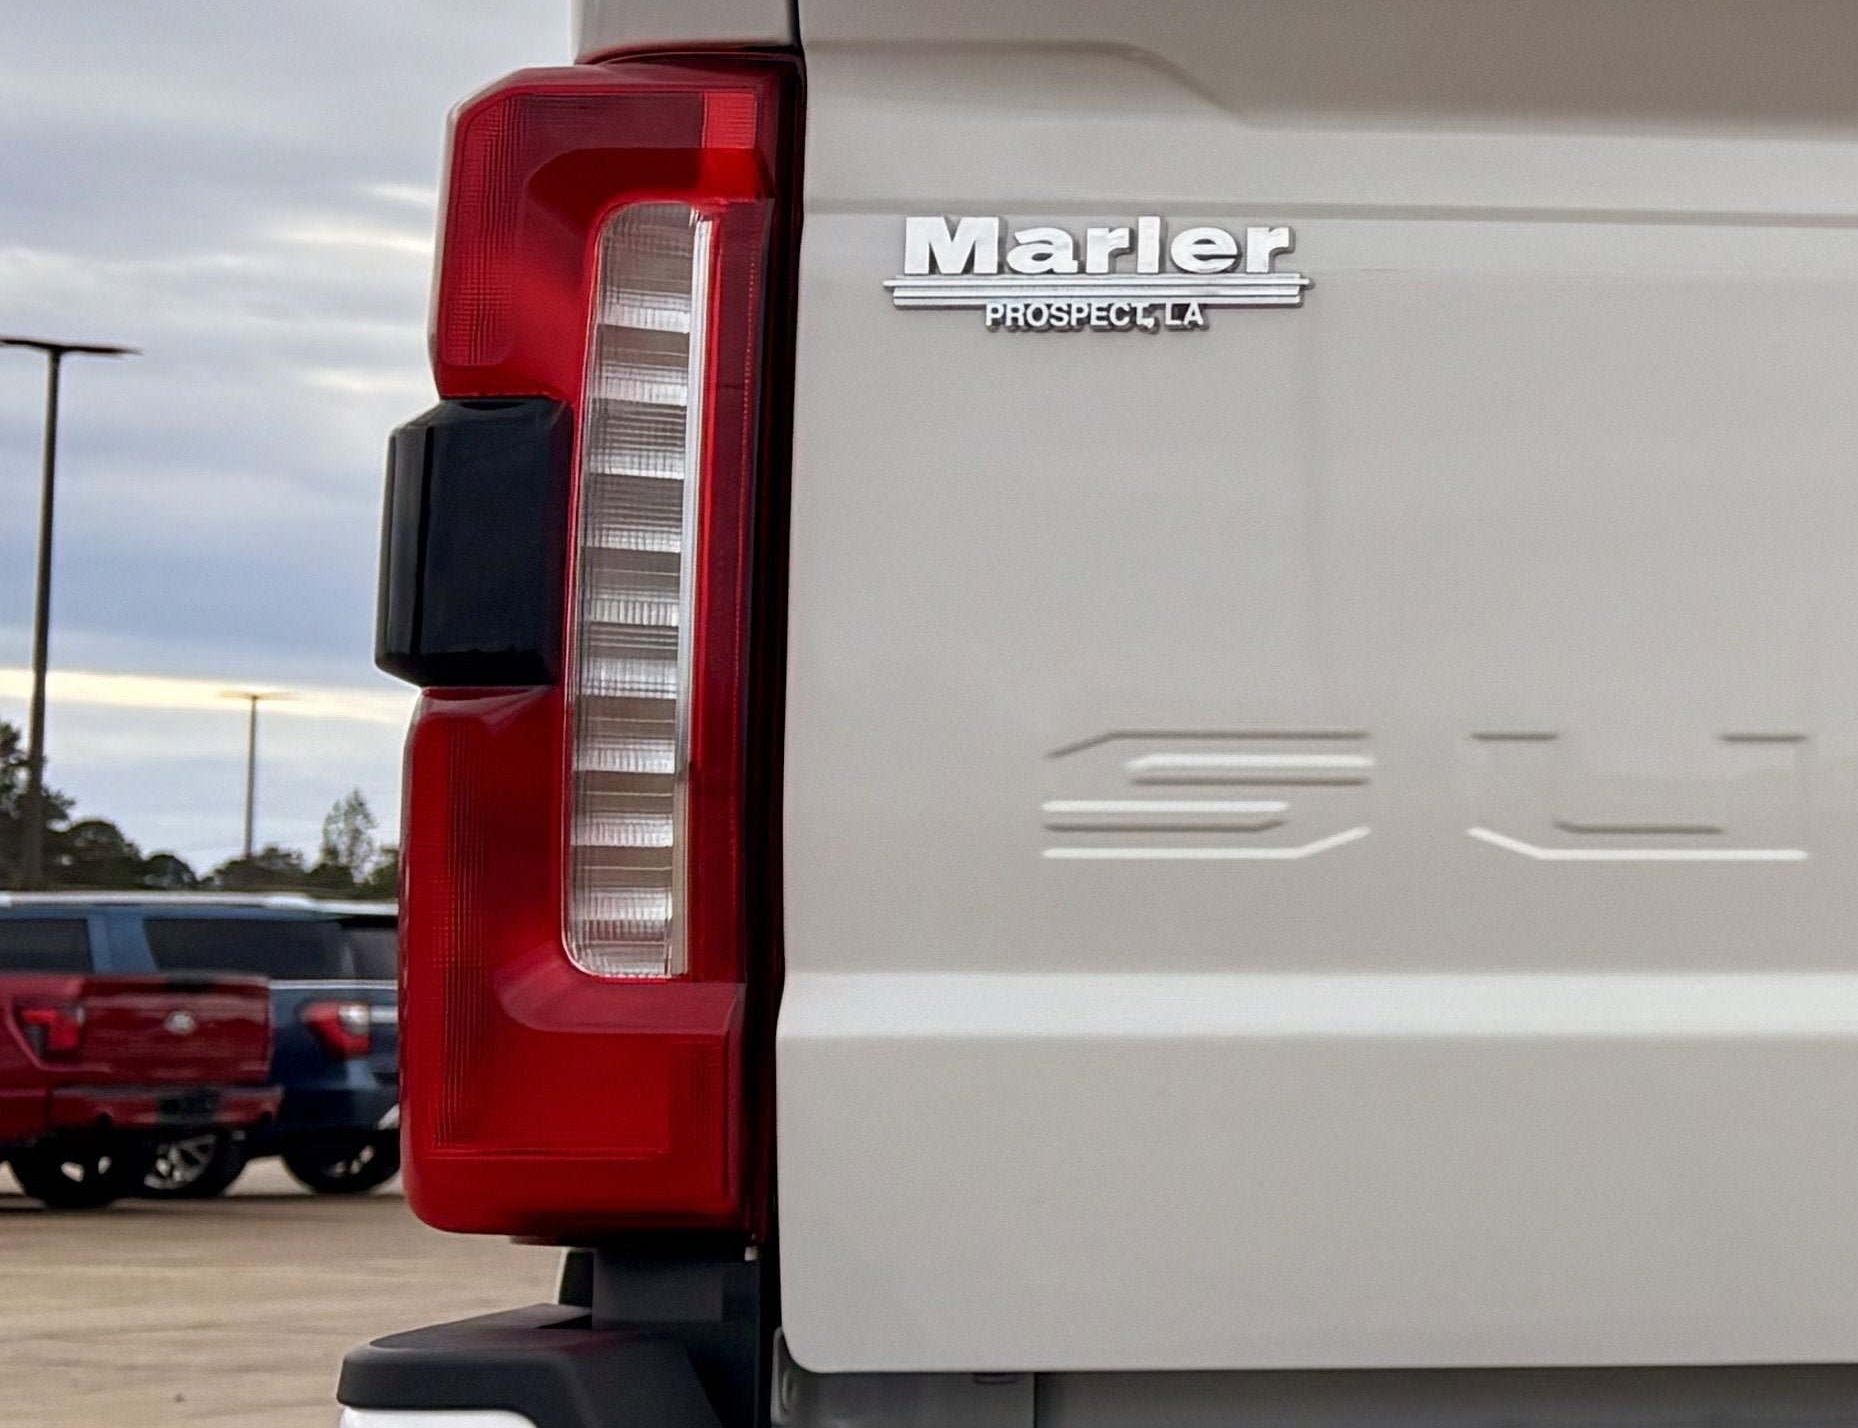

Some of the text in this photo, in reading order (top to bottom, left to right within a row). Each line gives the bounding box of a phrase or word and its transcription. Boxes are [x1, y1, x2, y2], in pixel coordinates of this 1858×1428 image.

[904, 215, 1293, 274] Marler
[985, 302, 1205, 330] PROSPECT, LA
